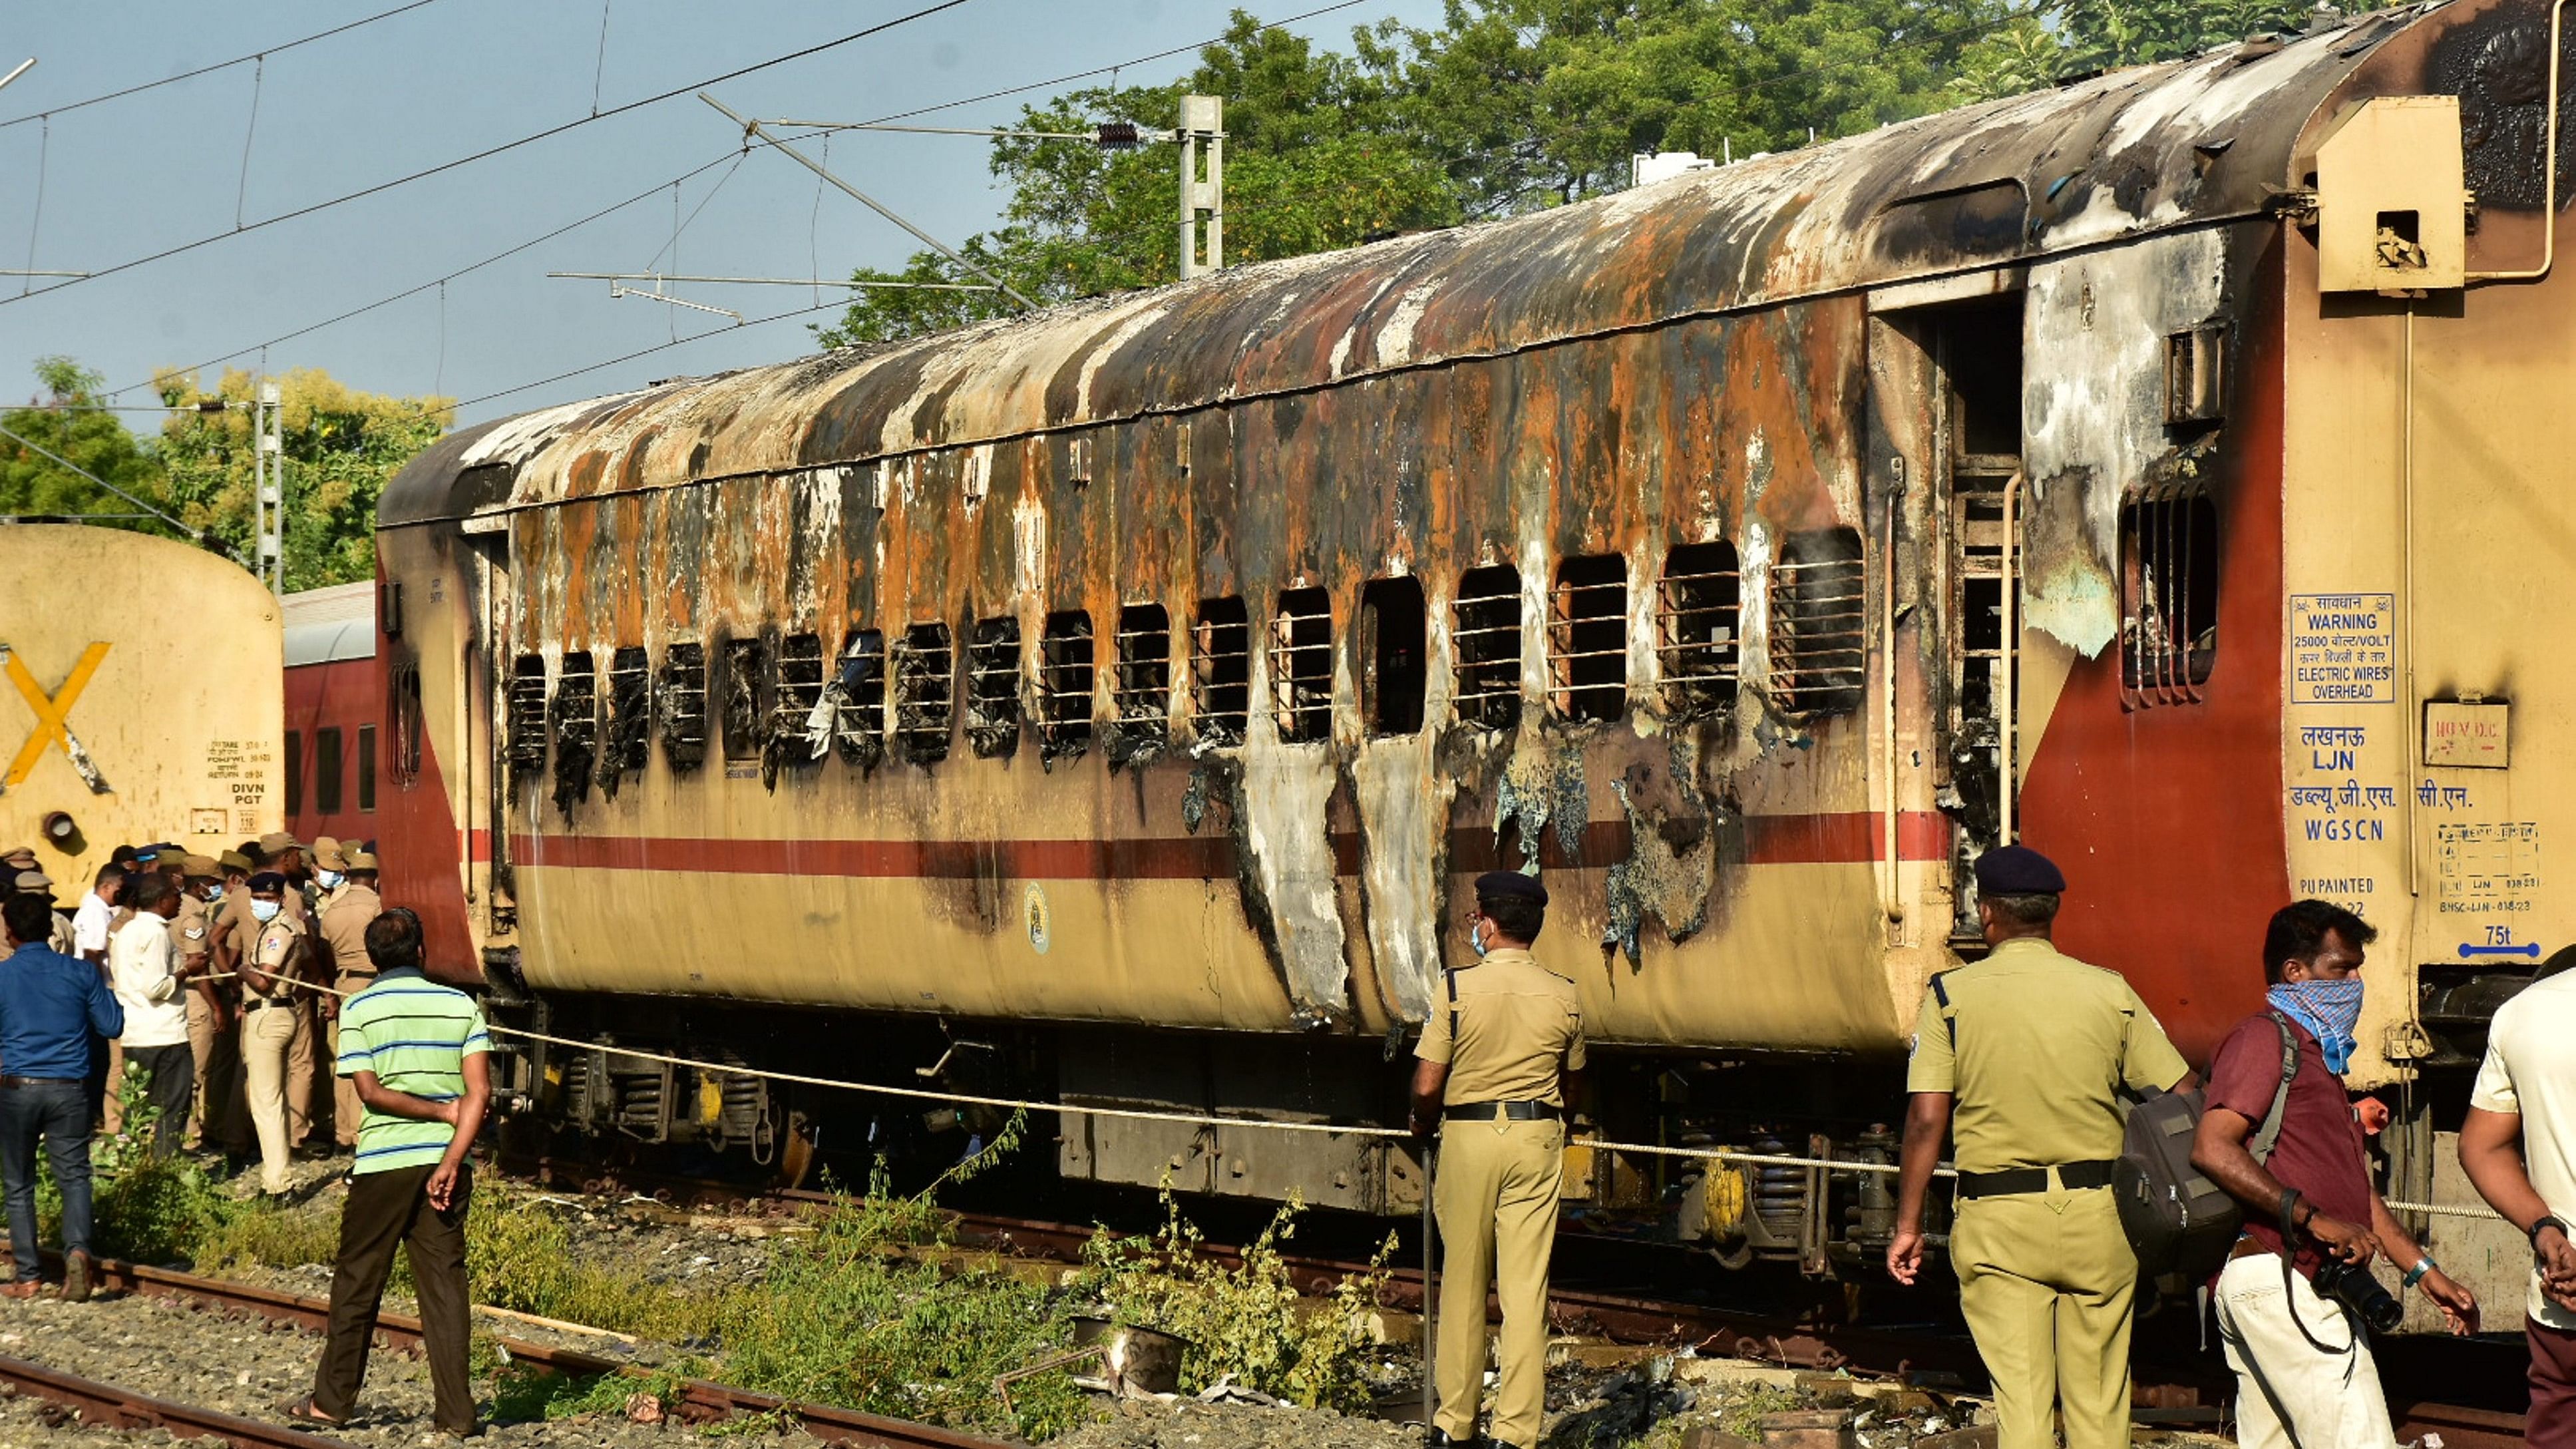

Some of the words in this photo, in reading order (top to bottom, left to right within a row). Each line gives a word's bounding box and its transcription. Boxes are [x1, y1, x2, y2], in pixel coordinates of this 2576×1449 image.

[2316, 597, 2362, 610] सावधान
[2308, 613, 2377, 630] WARNING
[2295, 636, 2328, 647] 25000
[2370, 652, 2385, 662] तार
[2298, 667, 2350, 682] ELECTRIC
[2354, 666, 2389, 680] WIRES
[2312, 684, 2373, 699] OVERHEAD
[2300, 727, 2365, 747] लखनऊ
[2313, 750, 2354, 770] LJN
[232, 784, 265, 793] DIVN
[2416, 779, 2473, 811] सी.एन.
[235, 795, 262, 804] PGT
[2305, 819, 2383, 841] WGSCN
[2300, 879, 2316, 895] PU
[2319, 878, 2373, 893] PAINTED
[2485, 925, 2511, 946] 75t
